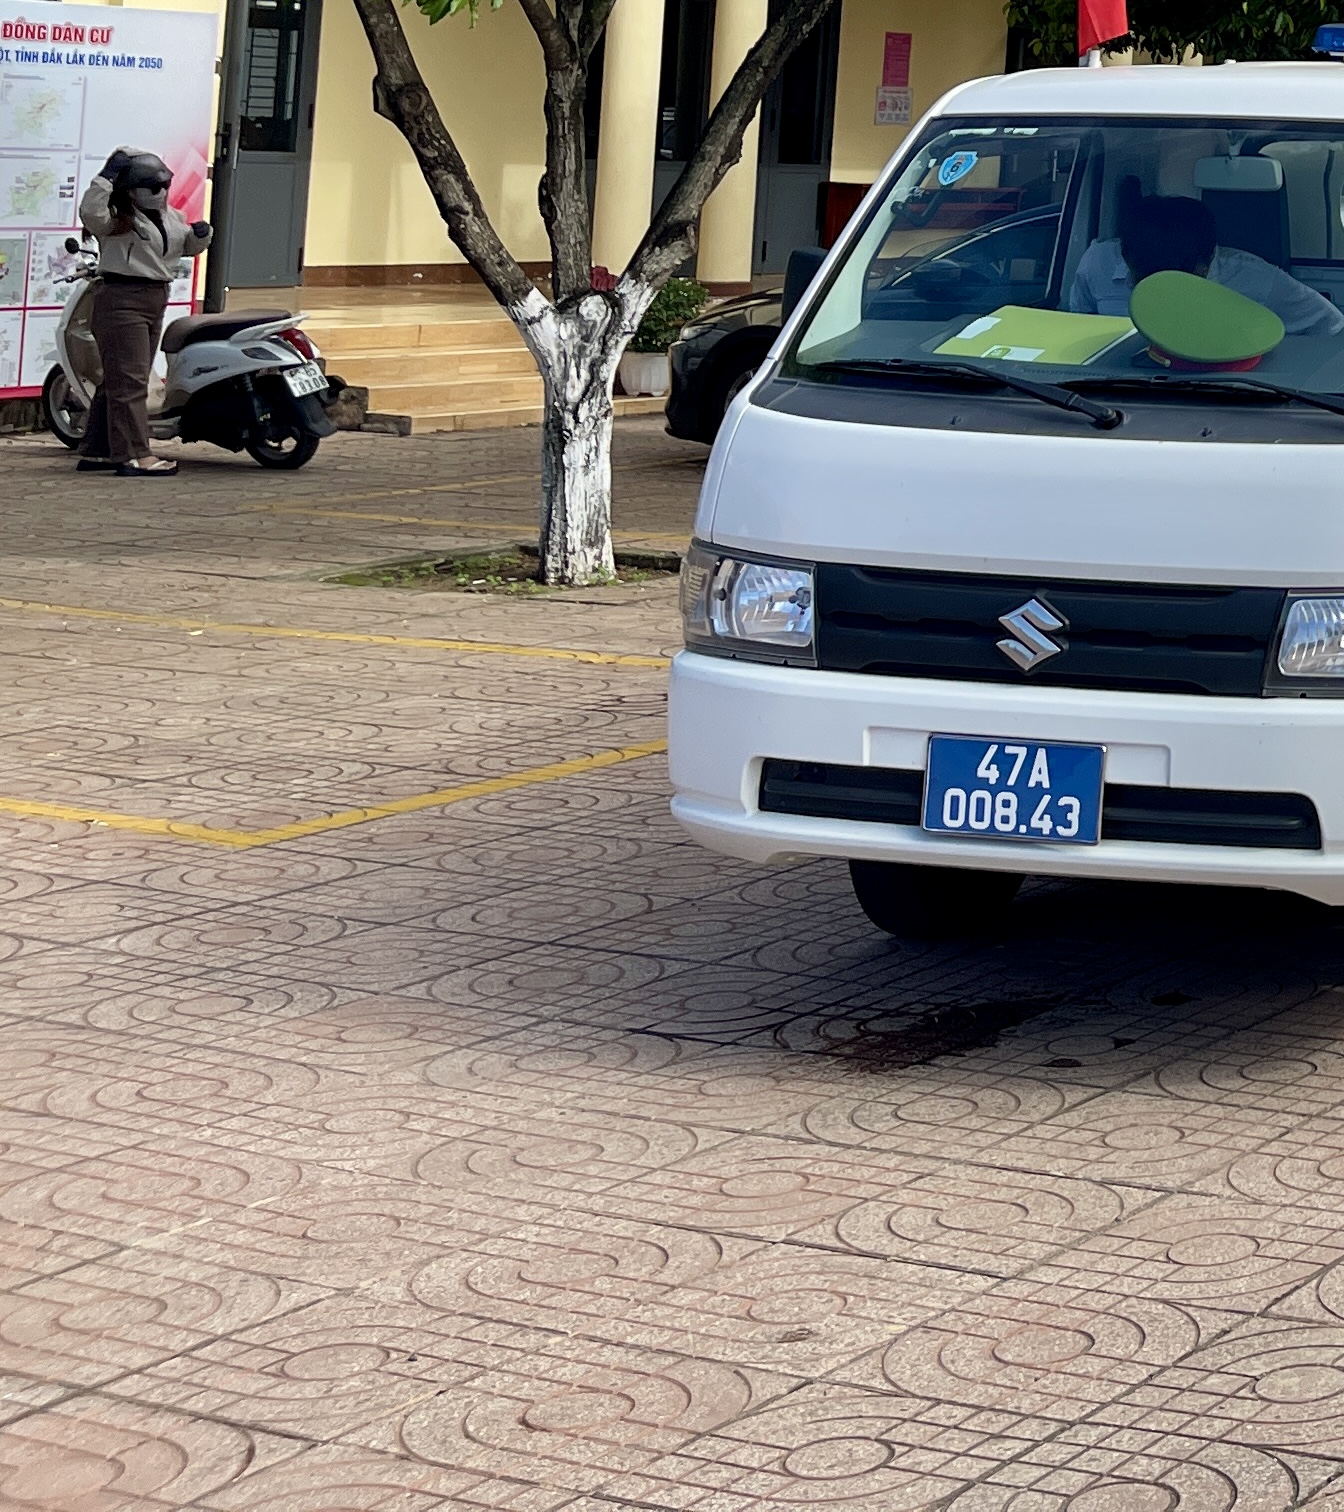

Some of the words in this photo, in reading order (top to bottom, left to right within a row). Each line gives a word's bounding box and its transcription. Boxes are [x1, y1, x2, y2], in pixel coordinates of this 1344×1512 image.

[2, 17, 47, 40] ĐỒNG
[51, 22, 85, 43] DÂN
[90, 26, 113, 44] CƯ
[15, 46, 39, 63] TỈNH
[42, 47, 63, 64] ĐẮK
[66, 49, 85, 66] LẮK
[88, 51, 109, 67] ĐẾN
[112, 54, 135, 68] NĂM
[139, 57, 163, 69] 2050
[976, 744, 1051, 788] 47A
[942, 788, 1081, 837] 008.43
